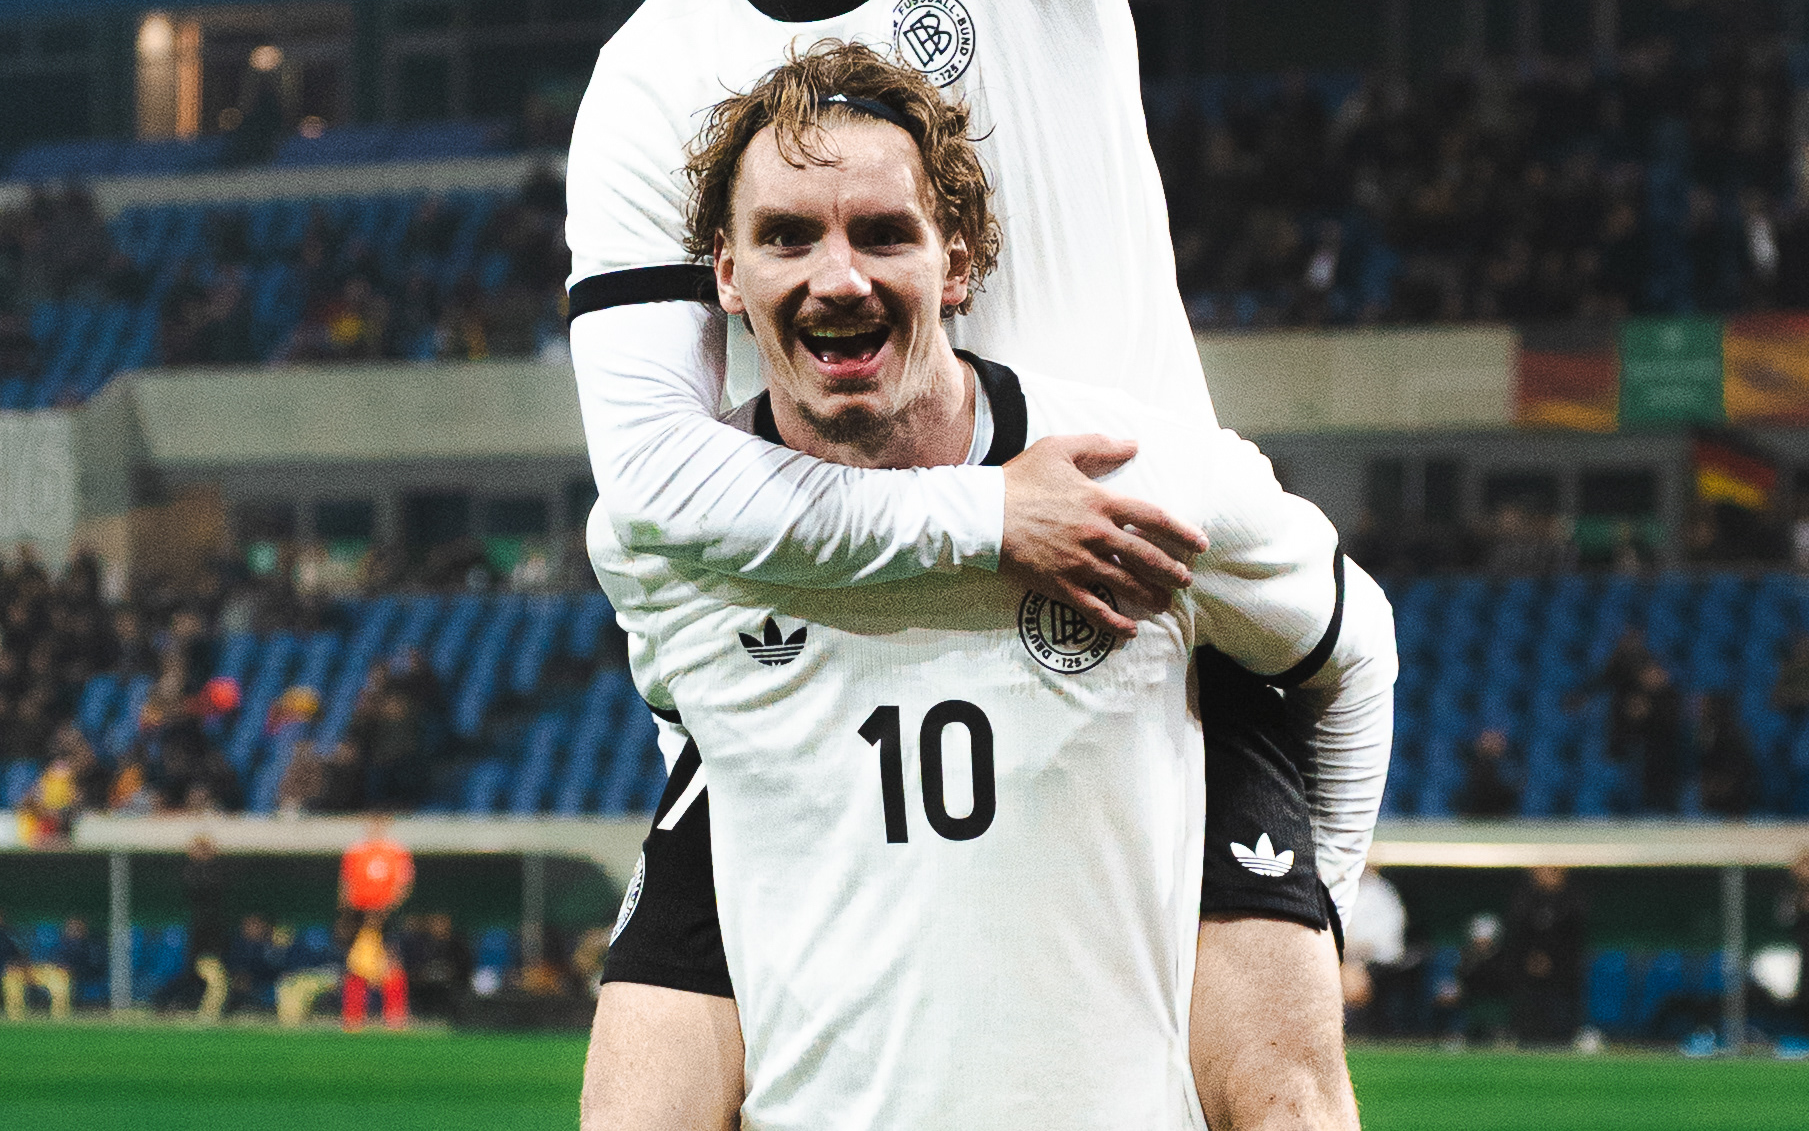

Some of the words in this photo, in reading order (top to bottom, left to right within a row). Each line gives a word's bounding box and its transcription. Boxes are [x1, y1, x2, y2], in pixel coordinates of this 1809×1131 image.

[939, 63, 959, 81] 125
[1024, 592, 1052, 659] DEUTSCH
[1062, 658, 1082, 669] 125
[857, 699, 997, 844] 10
